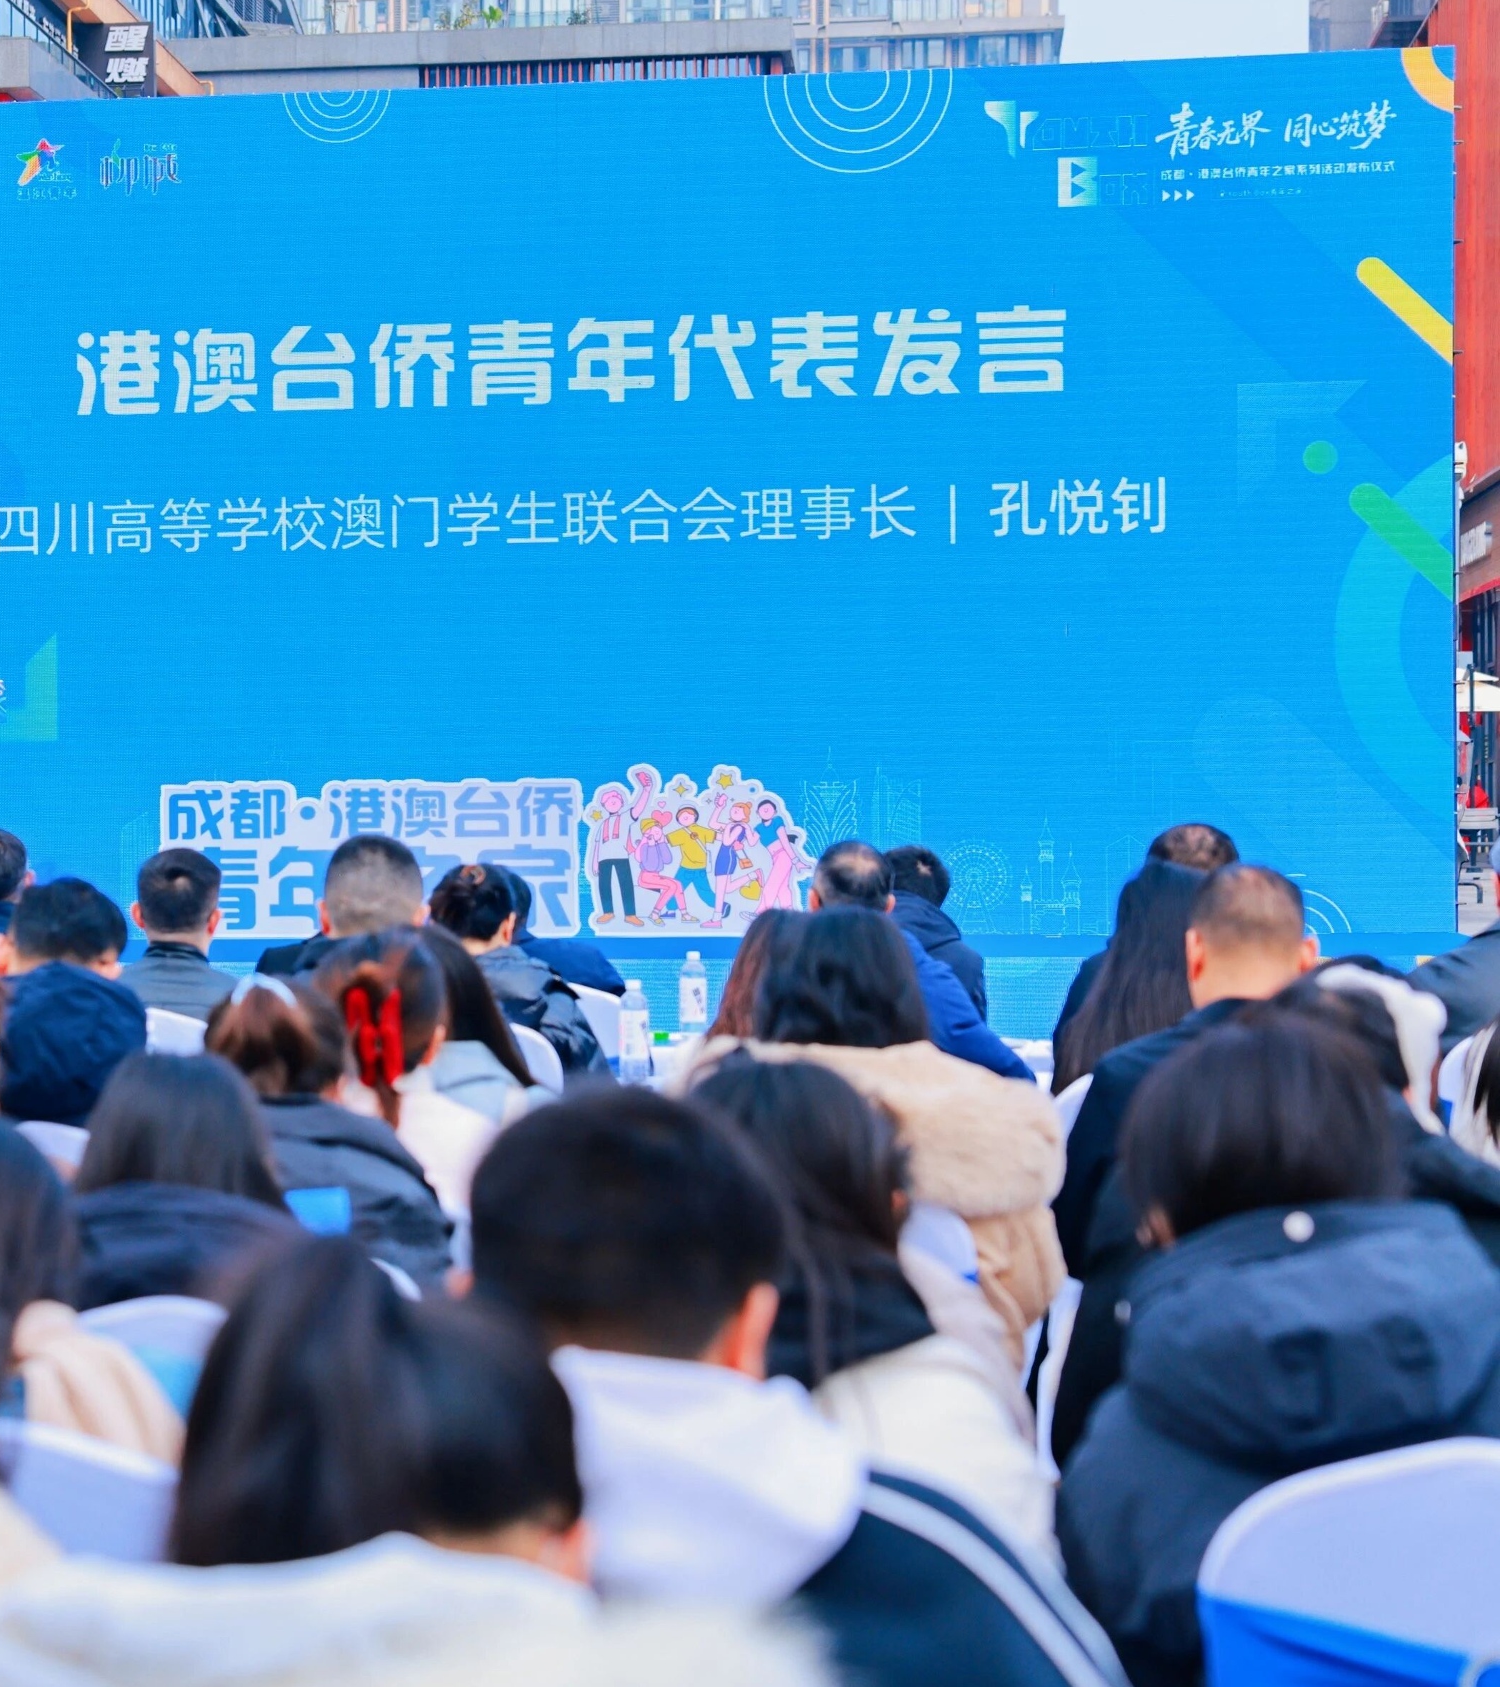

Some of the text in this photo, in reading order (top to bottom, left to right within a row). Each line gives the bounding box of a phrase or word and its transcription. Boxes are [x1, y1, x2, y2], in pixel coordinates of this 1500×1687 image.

[1155, 99, 1397, 160] 青春无界 同心筑梦
[76, 305, 1066, 416] 港澳台侨青年代表发言
[989, 477, 1167, 538] 孔悦钊
[169, 786, 574, 841] 成都·港澳台侨
